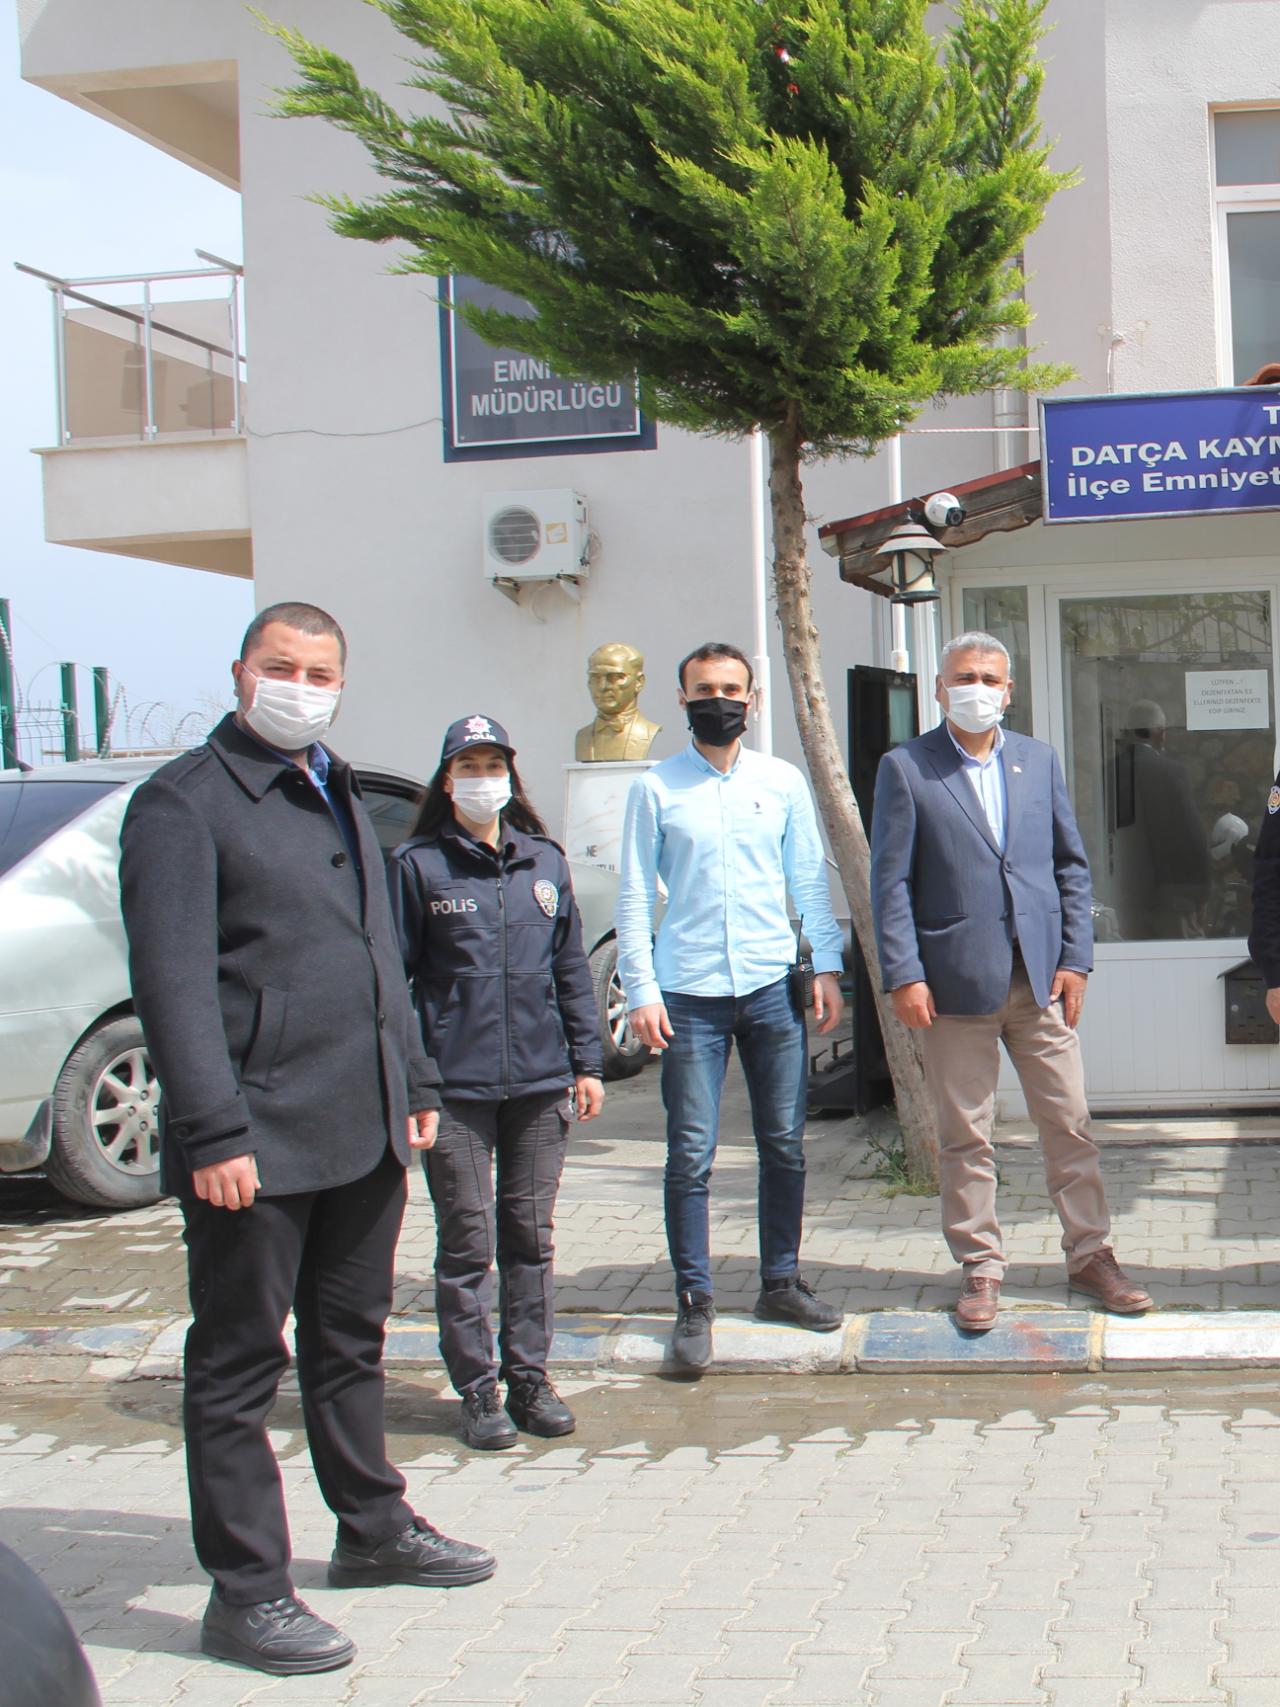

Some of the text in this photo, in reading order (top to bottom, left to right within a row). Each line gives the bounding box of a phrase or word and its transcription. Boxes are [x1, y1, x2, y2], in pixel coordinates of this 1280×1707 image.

[493, 358, 581, 382] EMNİ
[472, 380, 621, 416] MÜDÜRLÜĞÜ
[1071, 441, 1188, 467] DATÇA
[1067, 472, 1131, 501] İlçe
[586, 845, 598, 857] NE
[430, 898, 479, 916] POLİS
